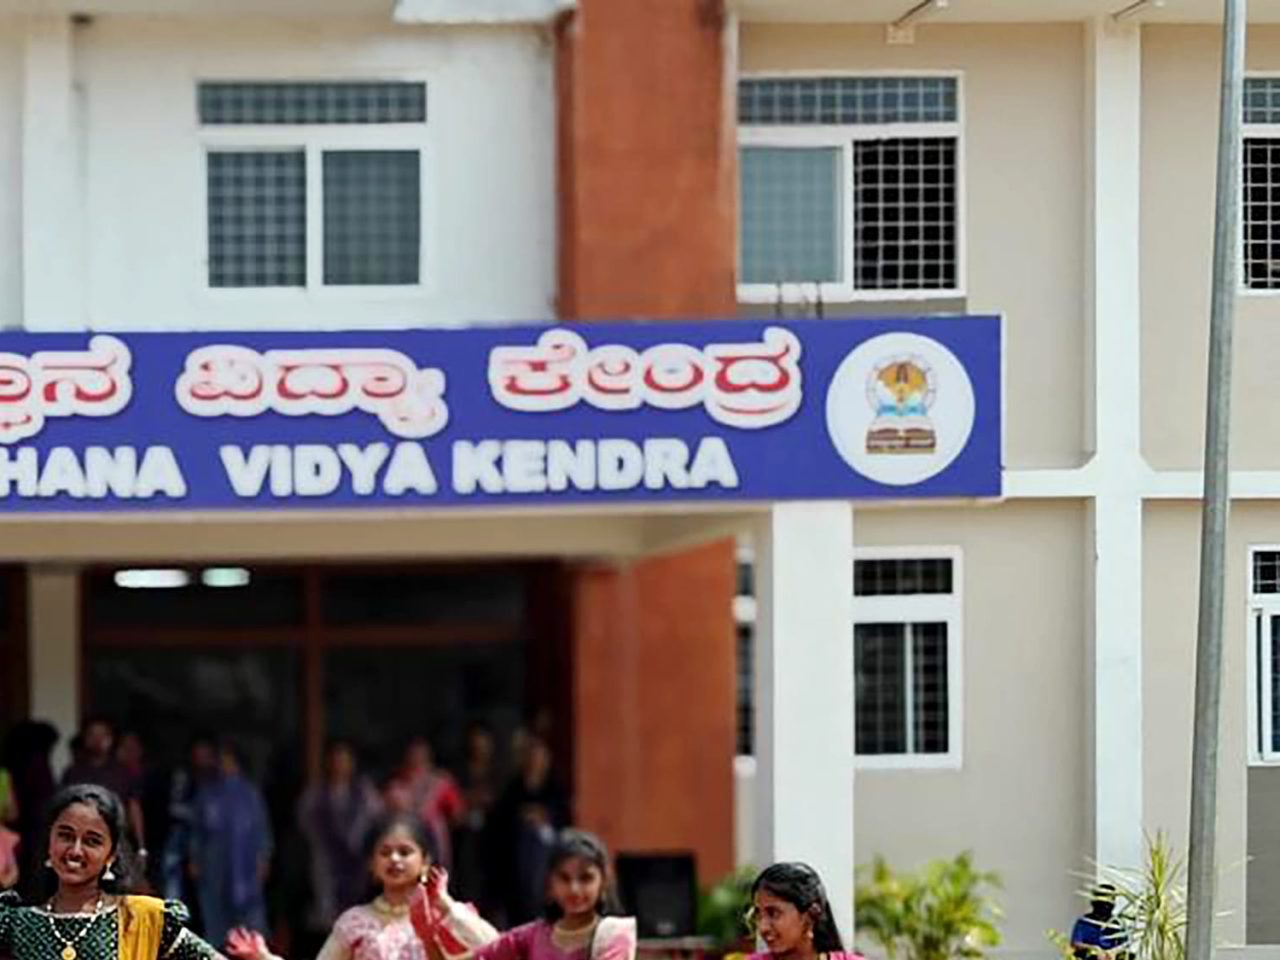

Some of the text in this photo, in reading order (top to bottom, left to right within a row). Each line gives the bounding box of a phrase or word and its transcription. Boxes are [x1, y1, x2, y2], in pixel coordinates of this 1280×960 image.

[176, 344, 448, 438] ವಿದ್ಯಾ
[488, 327, 801, 429] ಕೇಂದ್ರ
[220, 441, 438, 497] VIDYA
[452, 437, 739, 494] KENDRA
